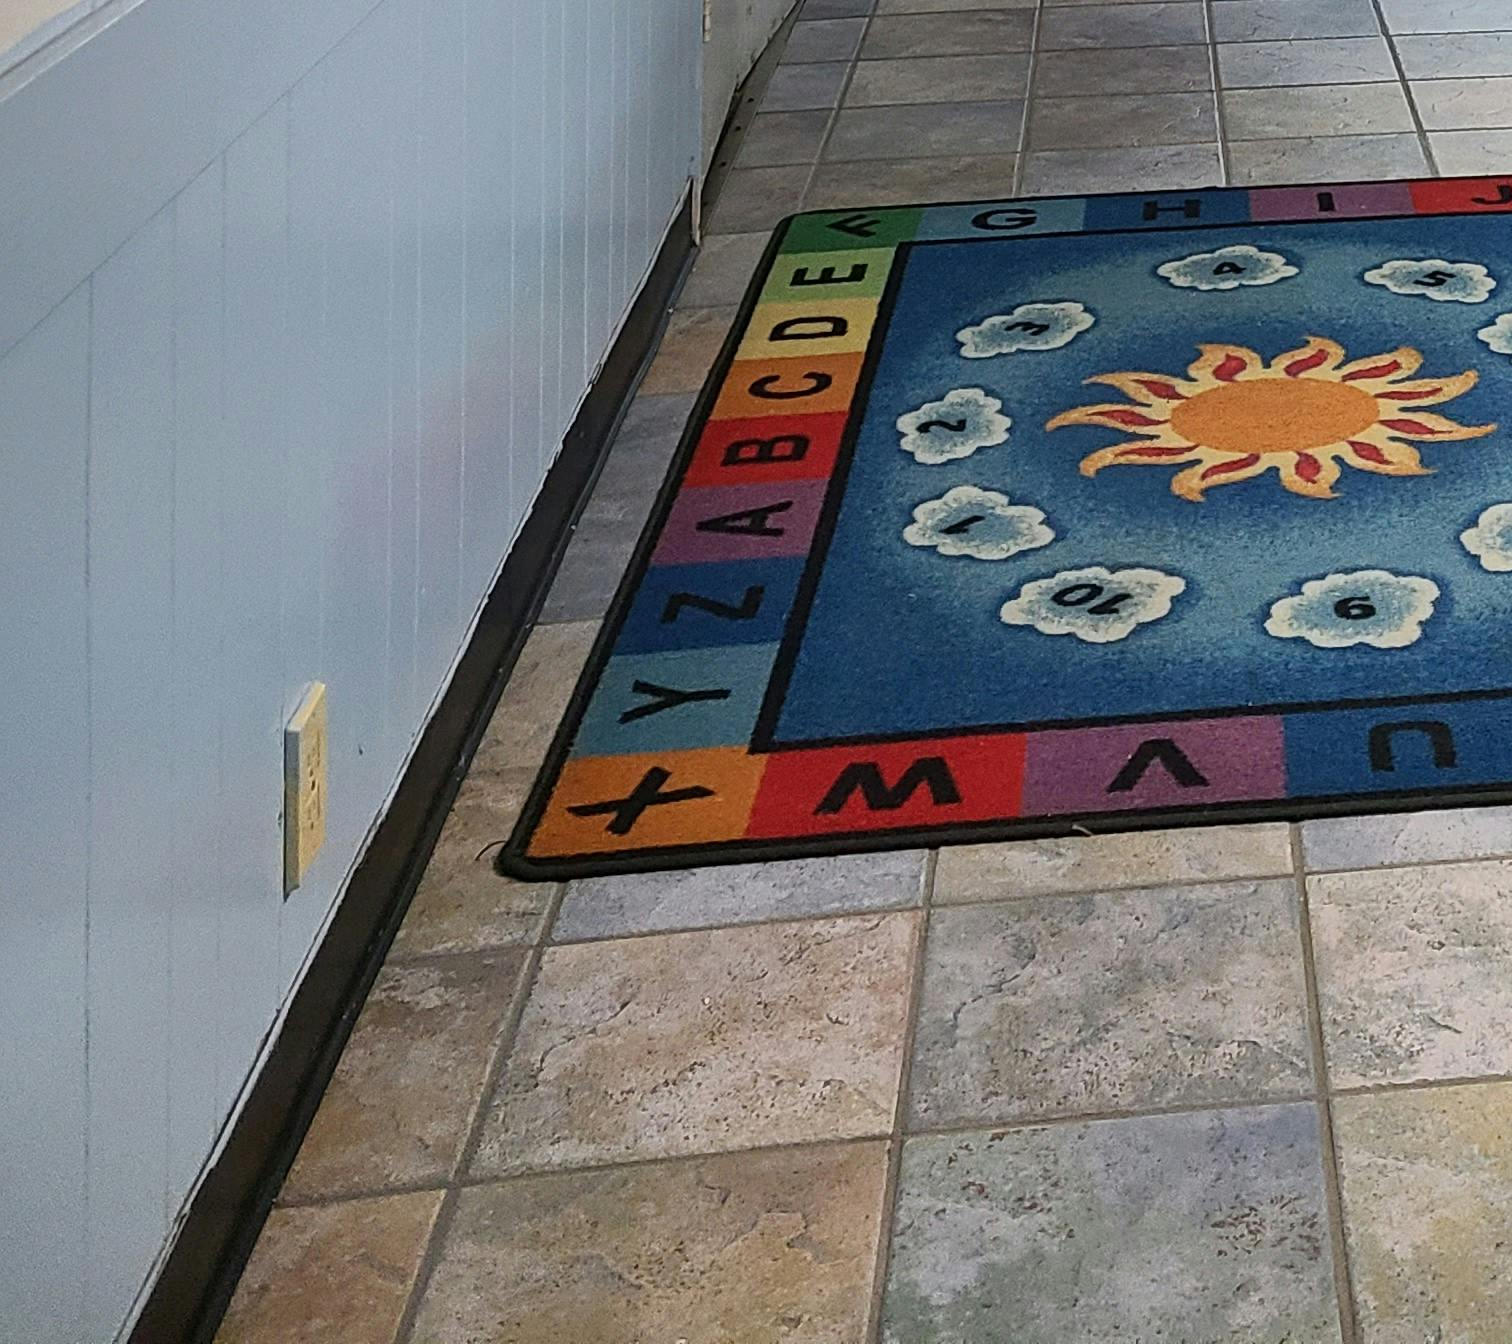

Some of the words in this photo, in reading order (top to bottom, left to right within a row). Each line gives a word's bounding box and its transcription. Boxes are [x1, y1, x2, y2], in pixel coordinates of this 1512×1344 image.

[1142, 199, 1201, 221] H
[1316, 192, 1337, 212] I
[826, 213, 881, 238] F
[971, 208, 1038, 230] G
[789, 263, 868, 287] E
[1212, 261, 1246, 276] 4
[1413, 270, 1456, 288] 5
[768, 316, 849, 341] D
[1004, 321, 1050, 336] 3
[748, 371, 832, 399] C
[916, 418, 967, 433] 2
[719, 433, 810, 468] B
[695, 499, 794, 538] A
[938, 514, 987, 536] 1
[660, 584, 765, 625] Z
[1051, 583, 1134, 616] 10
[618, 679, 731, 724] Y
[1368, 720, 1458, 773] U
[1105, 738, 1210, 793] V
[812, 755, 963, 815] W
[565, 765, 716, 836] X
